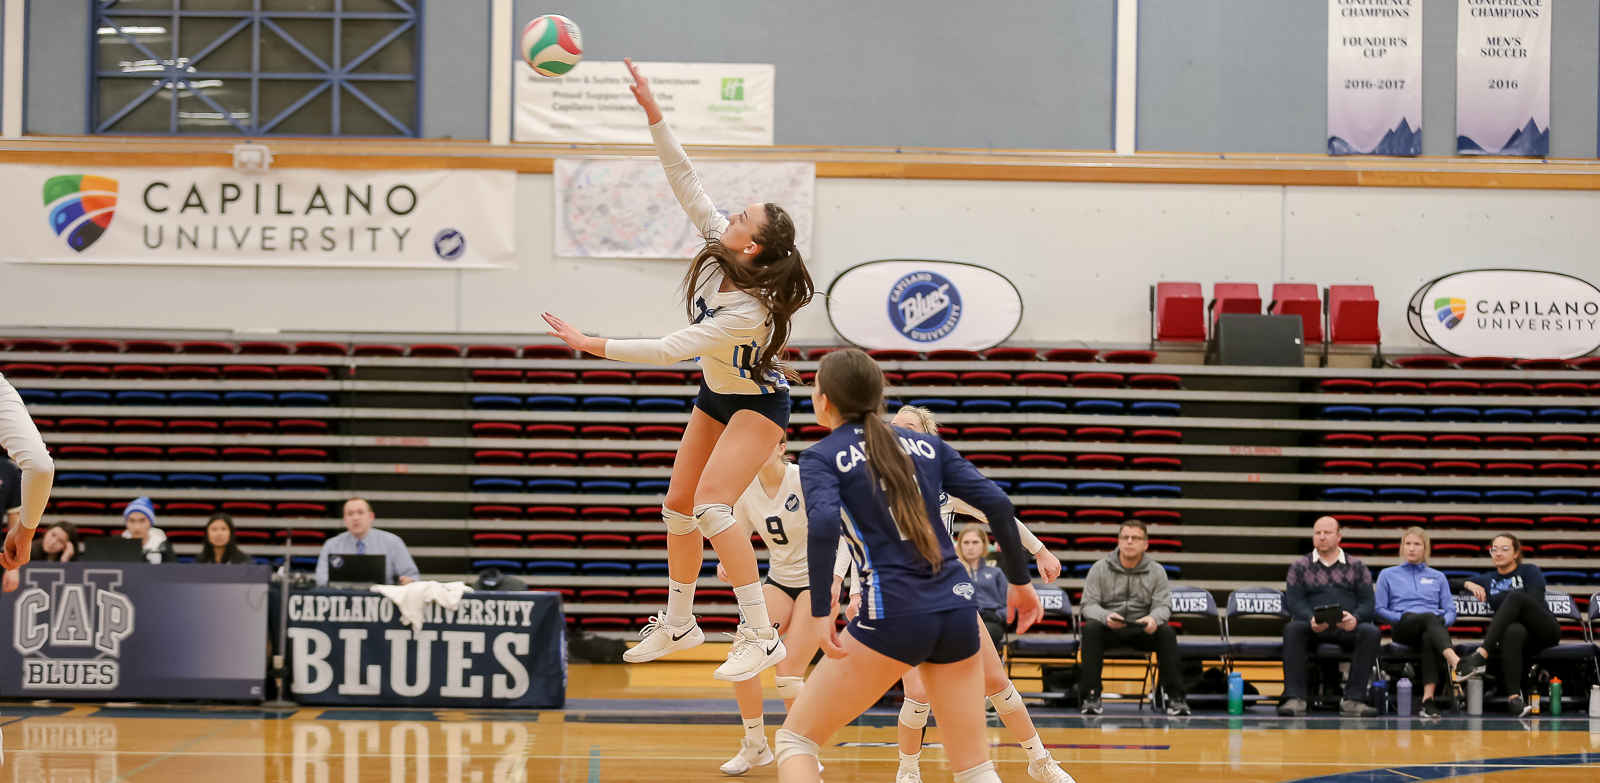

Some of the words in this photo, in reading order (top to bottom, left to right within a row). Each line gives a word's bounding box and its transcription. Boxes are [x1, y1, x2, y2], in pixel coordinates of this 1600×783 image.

[1341, 8, 1410, 18] CHAMPIONS
[1471, 8, 1540, 18] CHAMPIONS
[1342, 37, 1408, 47] FOUNDER'S
[1486, 36, 1522, 46] MEN'S
[1363, 48, 1387, 58] CUP
[1480, 48, 1527, 58] SOCCER
[1344, 79, 1405, 90] 2016-2017
[1488, 79, 1519, 89] 2016
[552, 91, 582, 100] Proud
[586, 91, 634, 101] Supporte
[598, 103, 645, 113] Universit
[143, 182, 418, 216] CAPILANO
[143, 224, 412, 252] UNIVERSITY
[890, 272, 933, 303] CAPILANO
[898, 282, 950, 333] Blues
[1476, 300, 1599, 316] CAPILANO
[1477, 318, 1596, 331] UNIVERSITY
[765, 516, 789, 546] 9
[288, 595, 393, 623] CAPILANO
[400, 599, 535, 627] NIVERSITY
[1171, 597, 1208, 612] LUES
[1235, 598, 1282, 613] BLUES
[13, 584, 135, 658] CAP
[288, 627, 530, 699] BLUES
[27, 663, 115, 685] BLUES
